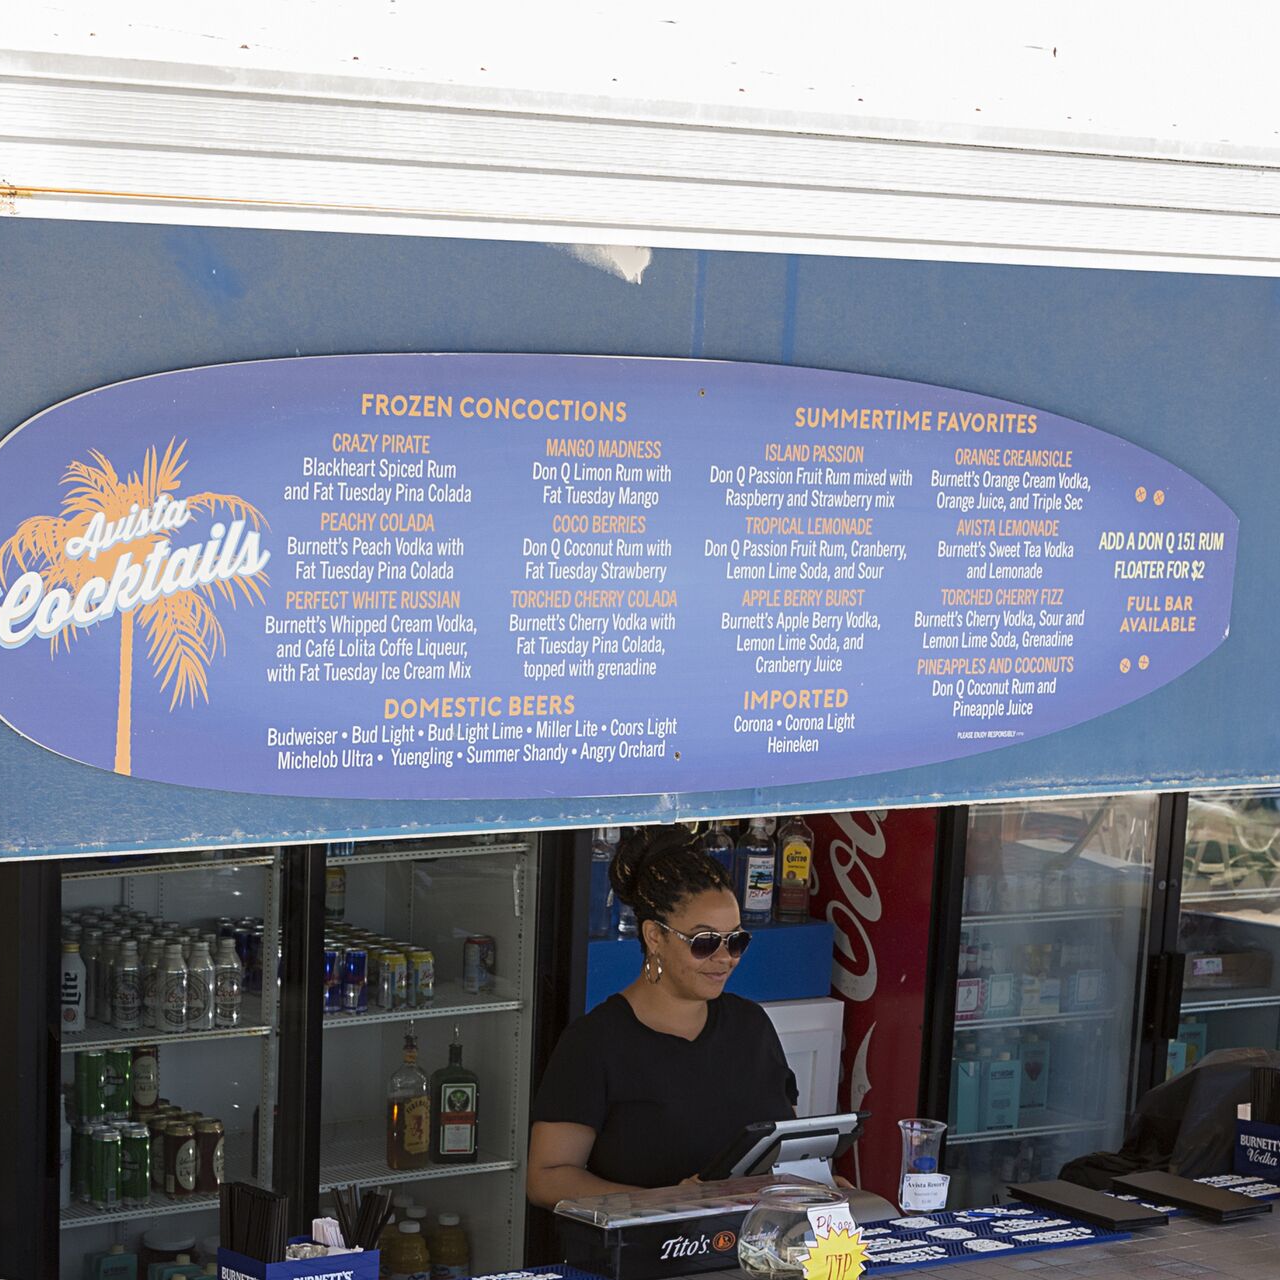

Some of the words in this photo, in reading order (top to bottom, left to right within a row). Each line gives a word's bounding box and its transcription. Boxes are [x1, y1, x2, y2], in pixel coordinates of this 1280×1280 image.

[361, 393, 453, 417] FROZEN
[459, 396, 627, 423] CONCOCTIONS
[794, 407, 933, 431] SUMMERTIME
[937, 411, 1038, 434] FAVORITES
[331, 432, 379, 453] CRAZY
[381, 433, 431, 455] PIRATE
[546, 437, 595, 459] MANGO
[597, 439, 662, 459] MADNESS
[765, 443, 811, 463] ISLAND
[812, 444, 865, 464] PASSION
[954, 447, 1001, 467] ORANGE
[1002, 448, 1073, 468] CREAMSICLE
[303, 457, 377, 478] Blackheart
[379, 458, 424, 482] Spiced
[427, 459, 457, 479] Rum
[65, 494, 192, 560] Avista
[1098, 531, 1125, 551] ADD
[1125, 531, 1136, 551] A
[1137, 531, 1164, 551] DON
[1165, 531, 1175, 555] Q
[1177, 531, 1196, 551] 151
[1197, 531, 1225, 551] RUM
[1113, 560, 1165, 579] FLOATER
[1166, 559, 1191, 579] FOR
[1190, 559, 1206, 582] $2
[285, 590, 350, 610] PERFECT
[351, 590, 398, 610] WHITE
[400, 590, 461, 609] RUSSIAN
[1127, 595, 1161, 613] FULL
[1164, 595, 1193, 612] BAR
[265, 615, 327, 635] Burnett's
[330, 614, 388, 637] Whipped
[391, 614, 433, 633] Cream
[435, 613, 477, 635] Vodka,
[1119, 615, 1197, 633] AVAILABLE
[384, 695, 503, 720] DOMESTIC
[508, 693, 575, 717] BEERS
[743, 688, 849, 711] IMPORTED
[267, 727, 339, 747] Budweiser
[351, 725, 379, 744] Bud
[381, 723, 415, 747] Light
[427, 722, 455, 742] Bud
[457, 721, 490, 745] Light
[491, 721, 524, 740] Lime
[535, 719, 573, 739] Miller
[575, 719, 599, 738] Lite
[610, 718, 644, 737] Coors
[647, 717, 678, 739] Light
[733, 715, 774, 733] Corona
[785, 713, 825, 732] Corona
[826, 712, 856, 733] Light
[767, 735, 819, 753] Heineken
[62, 972, 81, 1006] Lite
[1246, 1148, 1278, 1167] Vodka
